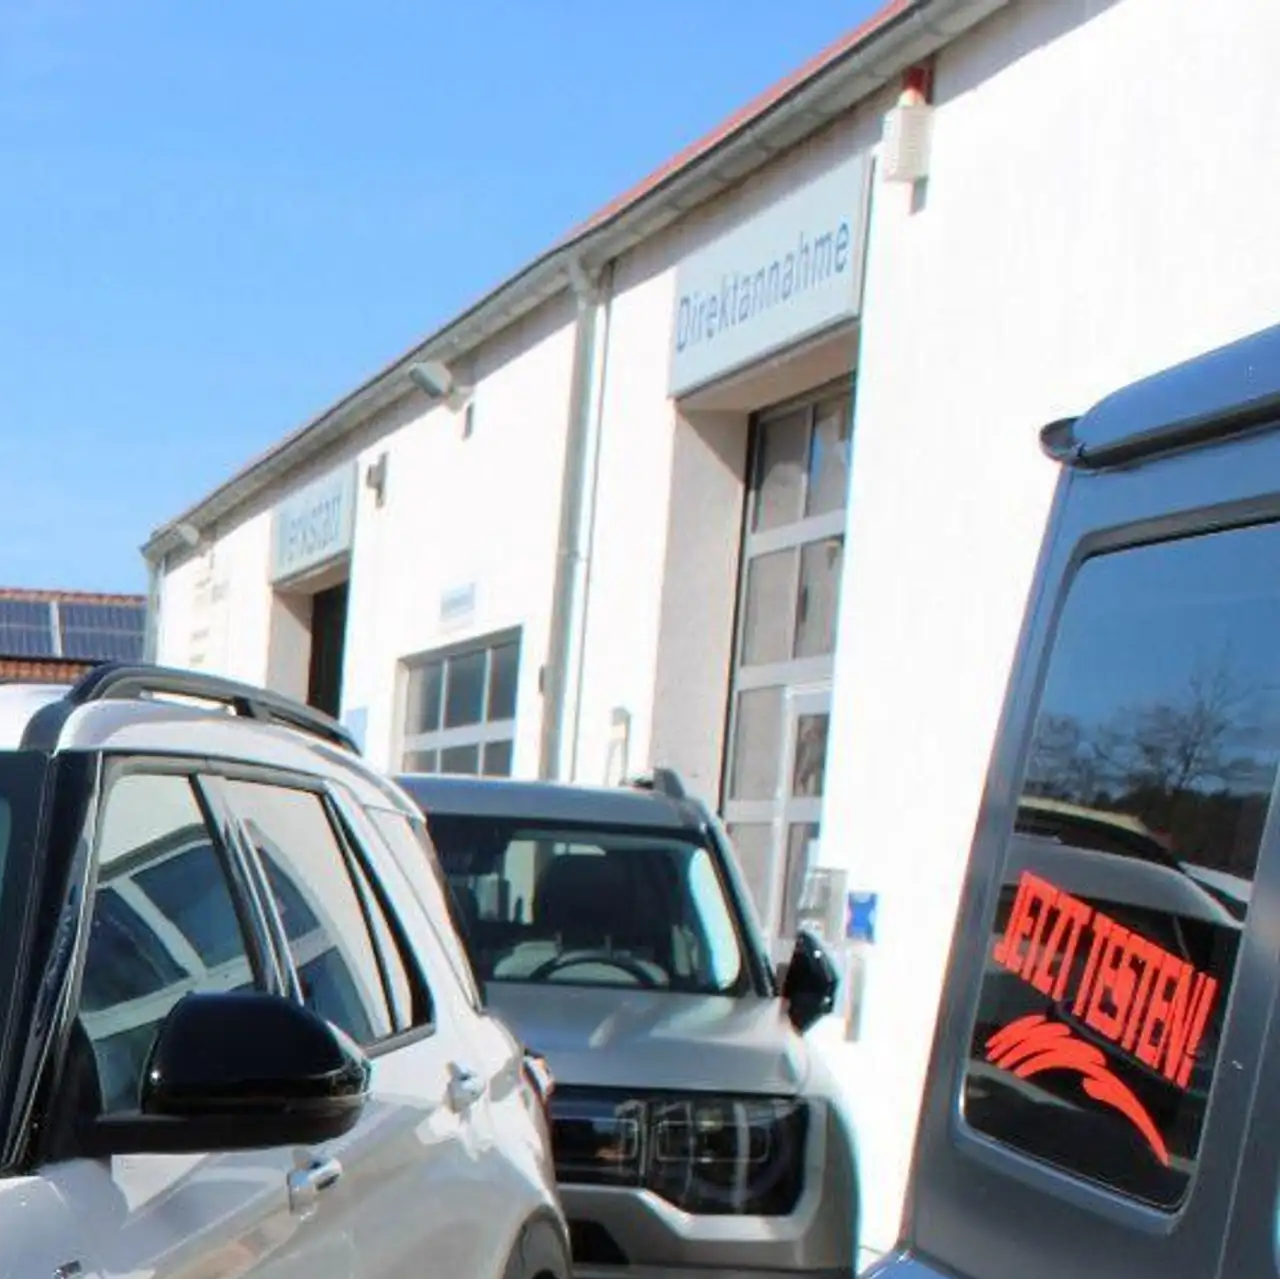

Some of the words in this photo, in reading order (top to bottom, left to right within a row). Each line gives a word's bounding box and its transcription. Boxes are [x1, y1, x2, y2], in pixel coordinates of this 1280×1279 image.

[676, 221, 850, 352] Direktannahme
[993, 870, 1092, 1002] JETZT
[1071, 911, 1219, 1090] TESTEN!
